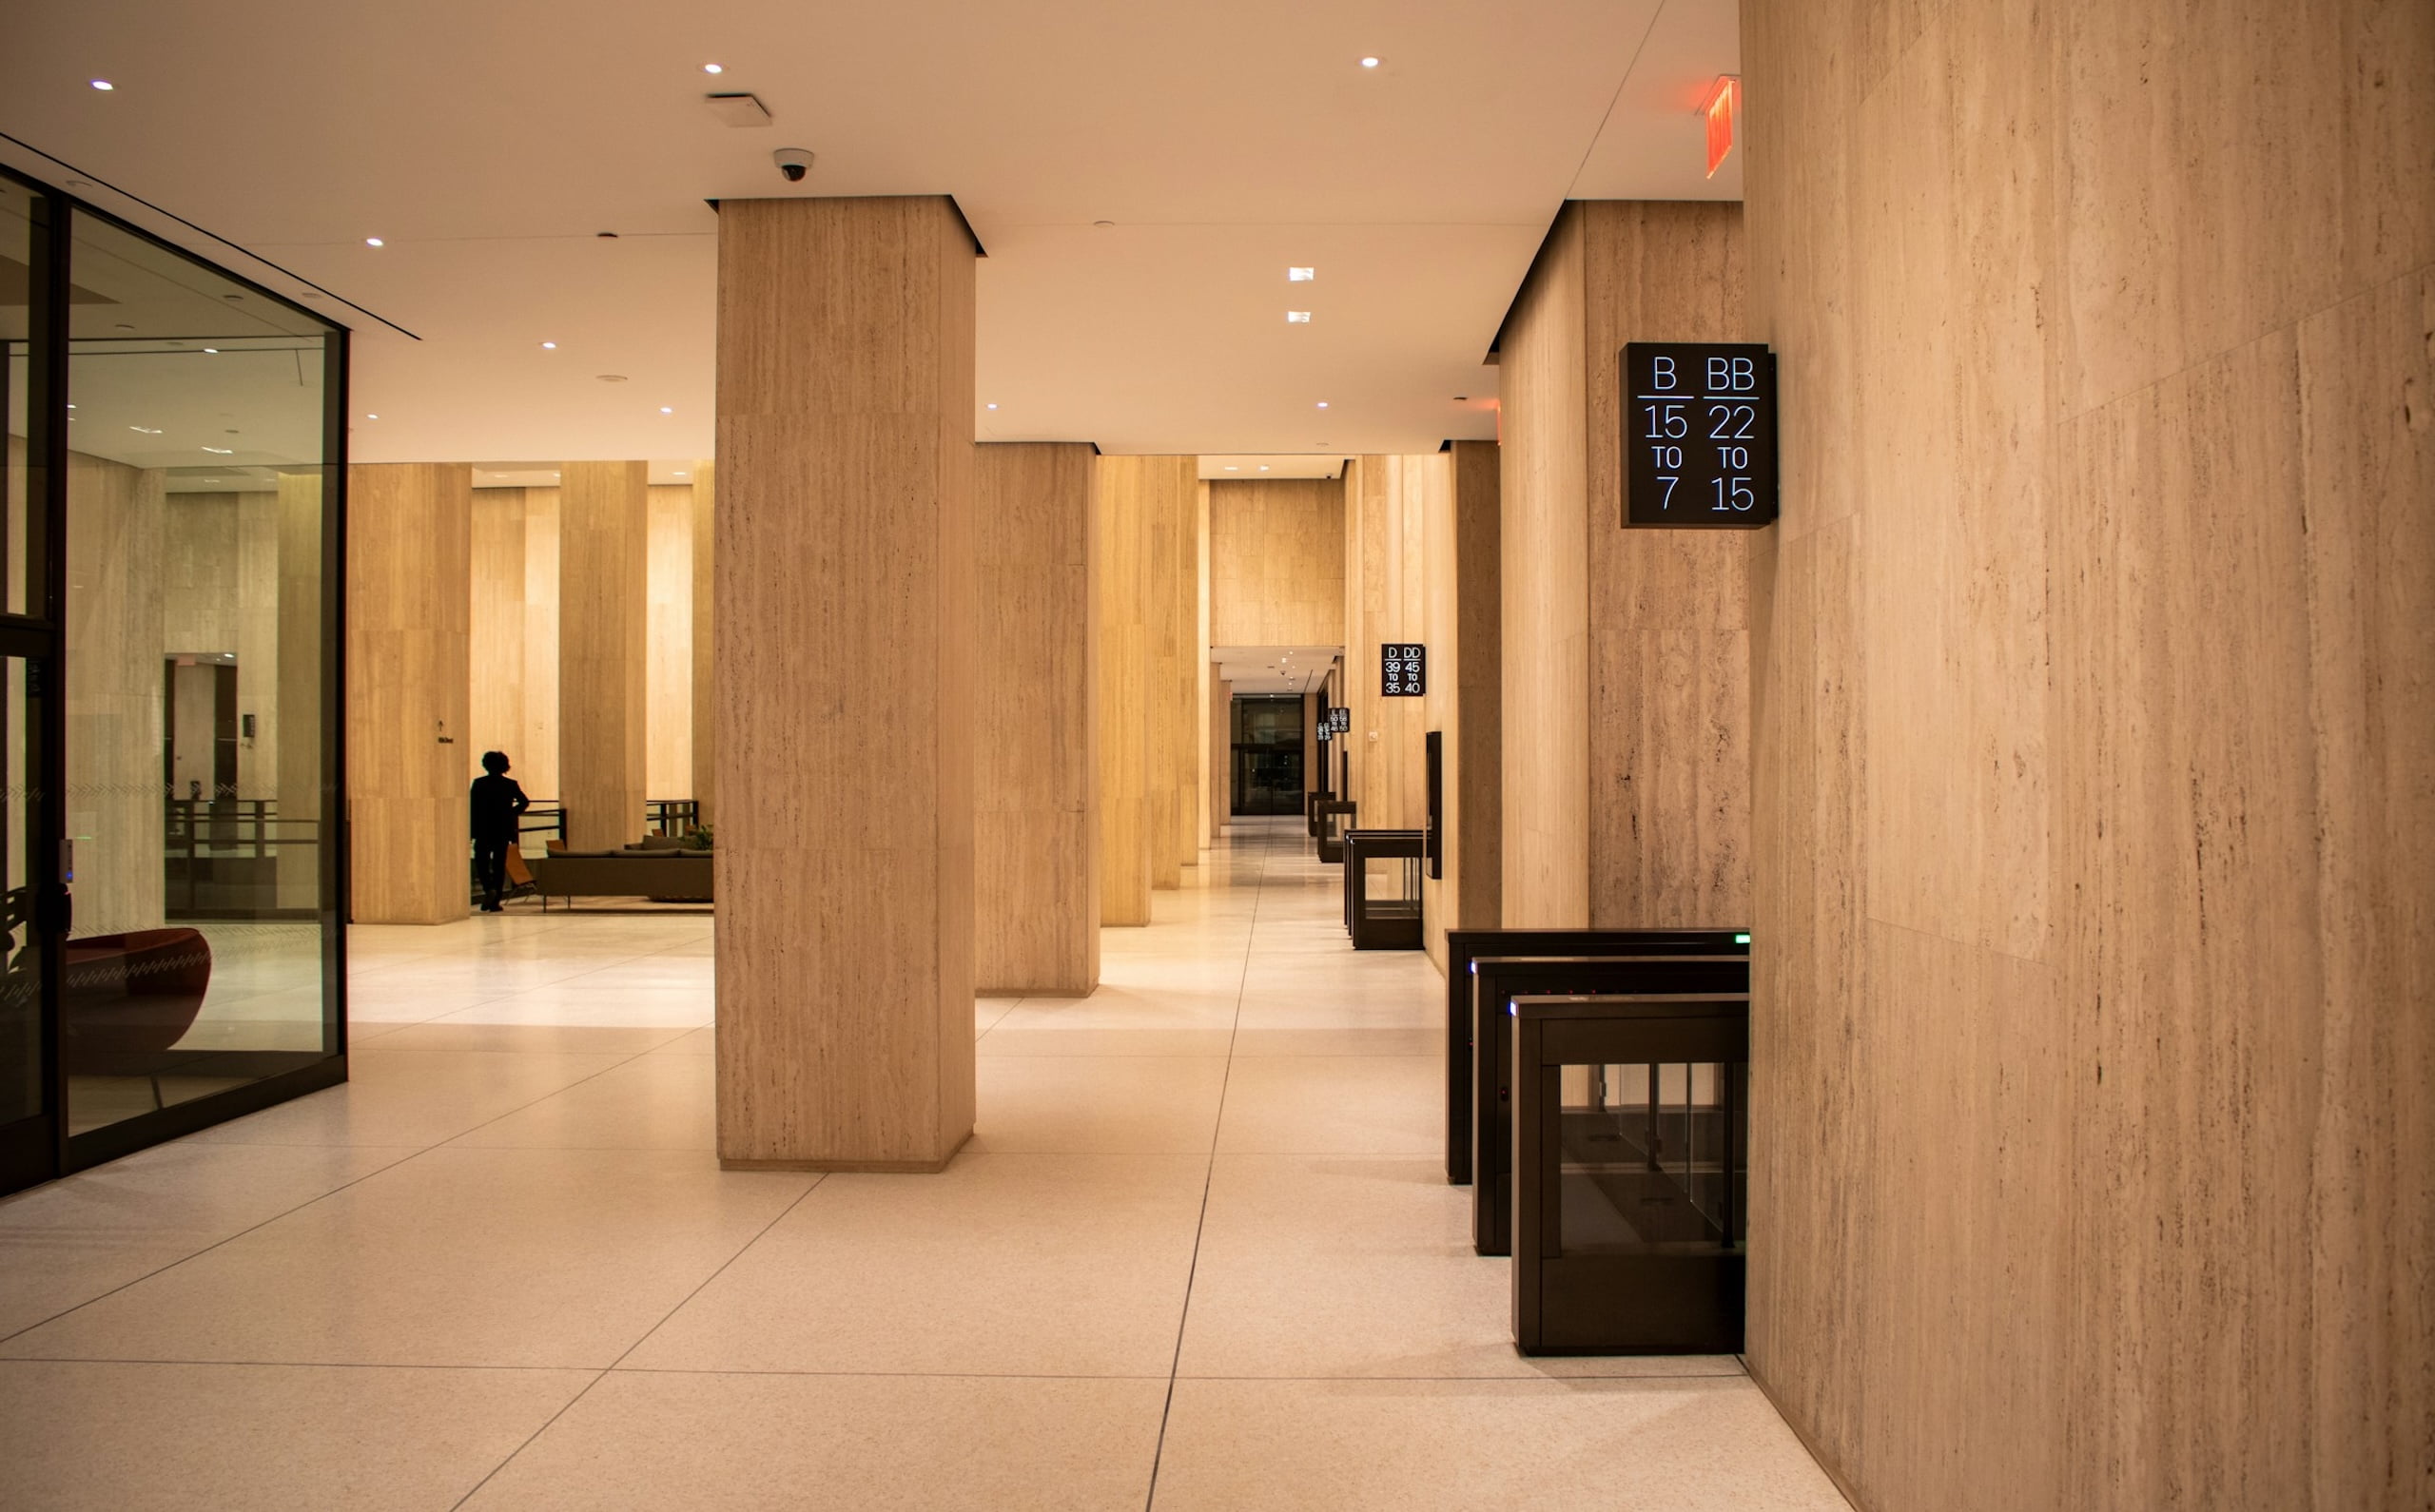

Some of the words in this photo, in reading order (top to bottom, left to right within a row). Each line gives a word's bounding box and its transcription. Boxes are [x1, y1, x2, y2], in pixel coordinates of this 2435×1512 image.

[1655, 357, 1676, 389] B
[1708, 358, 1754, 390] BB
[1646, 405, 1687, 438] 15
[1709, 405, 1754, 438] 22
[1651, 446, 1682, 468] TO
[1718, 447, 1747, 469] TO
[1657, 476, 1679, 509] 7
[1712, 477, 1753, 511] 15
[1389, 648, 1397, 658] D
[1404, 648, 1420, 658] DD
[1386, 662, 1400, 672] 39
[1405, 662, 1419, 672] 45
[1386, 683, 1400, 693] 35
[1405, 683, 1420, 693] 40
